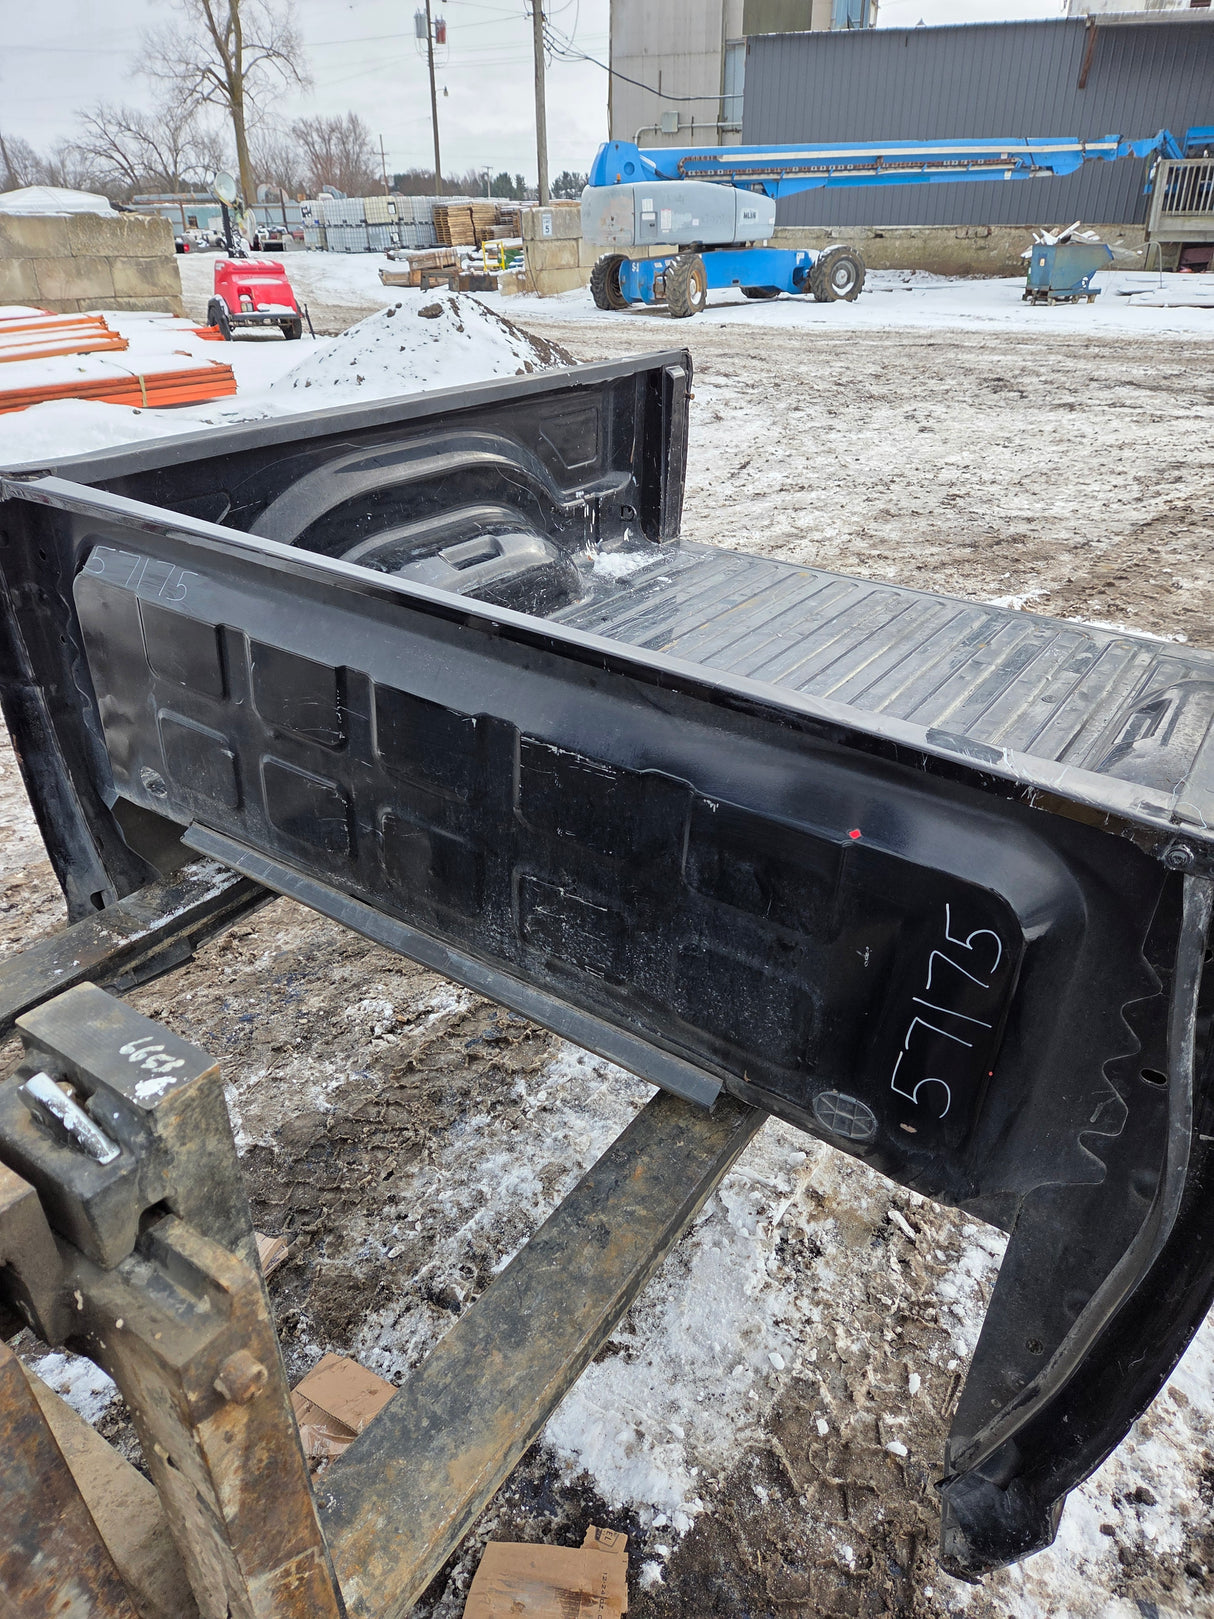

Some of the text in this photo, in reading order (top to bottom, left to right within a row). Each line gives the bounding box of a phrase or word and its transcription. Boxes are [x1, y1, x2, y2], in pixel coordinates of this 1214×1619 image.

[545, 225, 550, 234] 5
[83, 545, 199, 602] 57175
[890, 903, 1002, 1119] 57175
